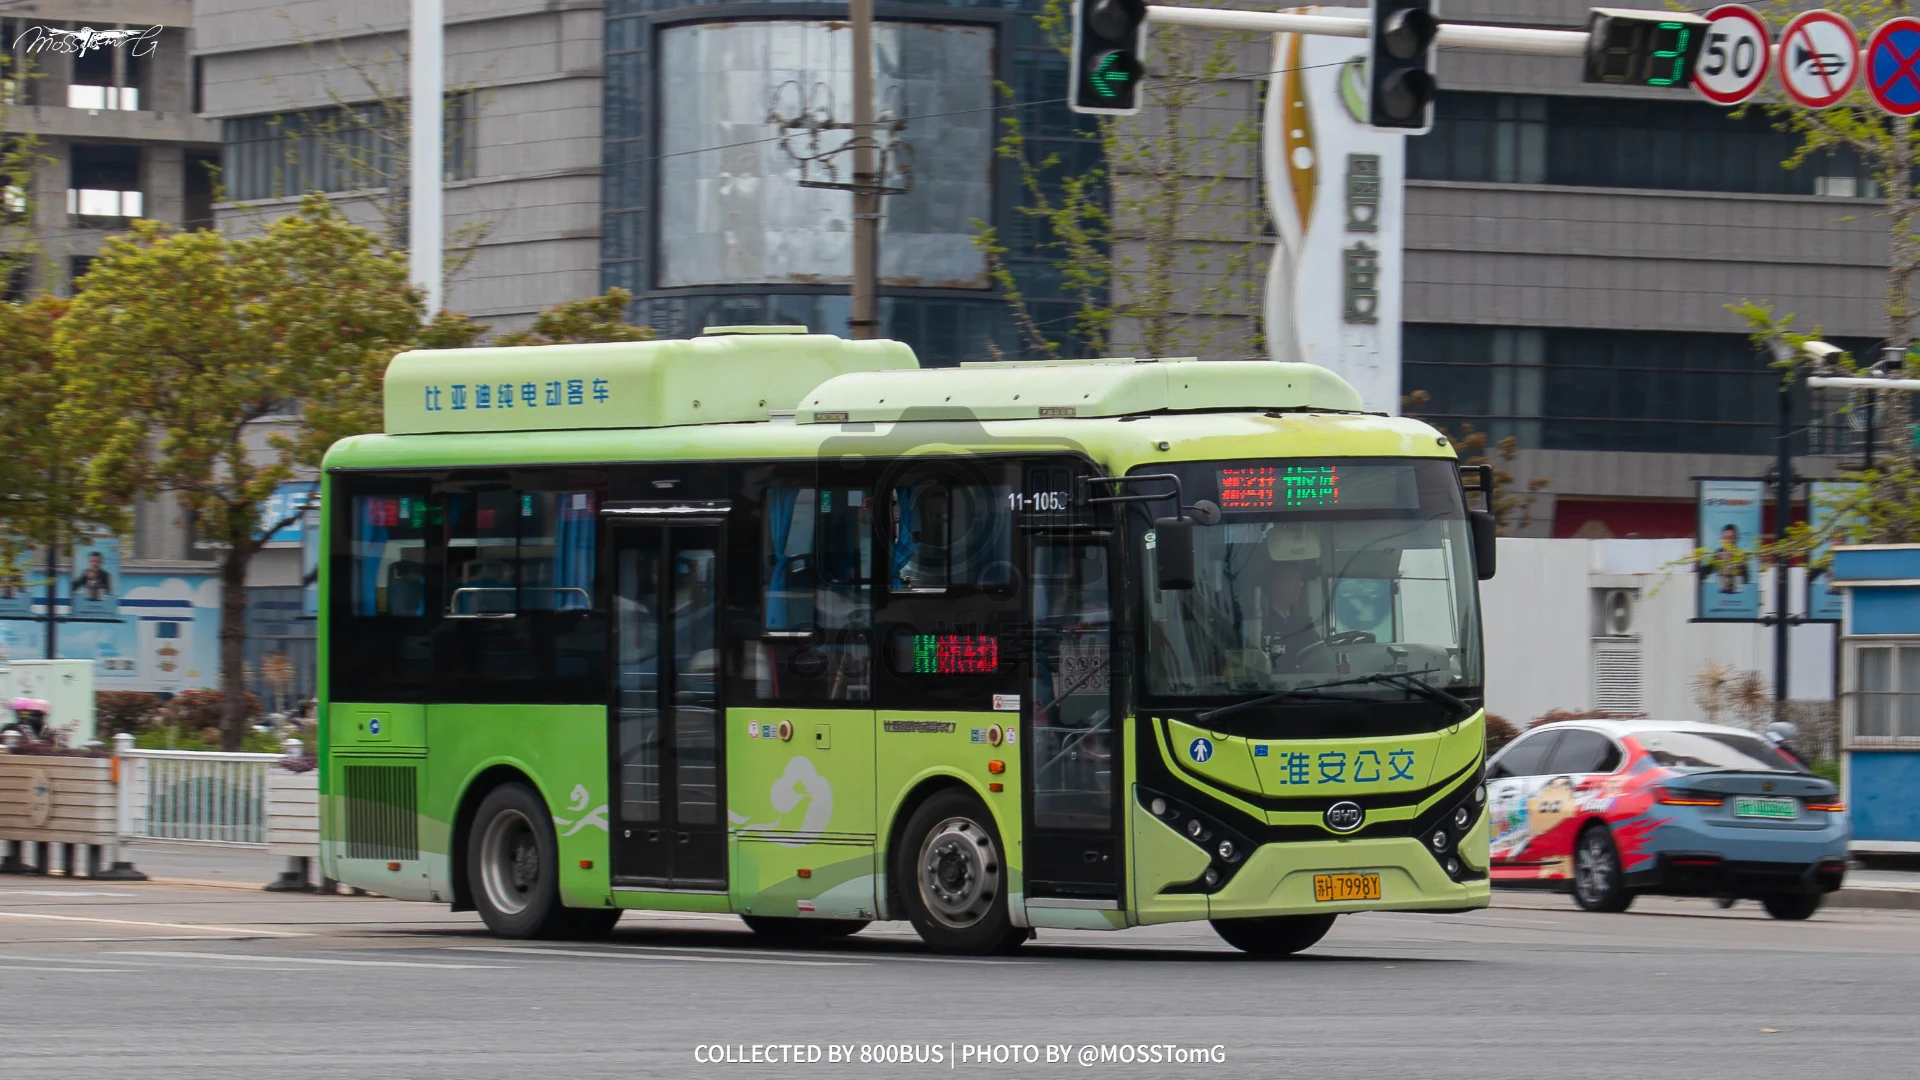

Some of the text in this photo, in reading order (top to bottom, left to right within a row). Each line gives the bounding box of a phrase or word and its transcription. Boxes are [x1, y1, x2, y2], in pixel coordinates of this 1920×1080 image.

[1645, 22, 1691, 85] 3
[1703, 33, 1755, 78] 50
[425, 378, 609, 411] 比亚迪纯电动客车
[1280, 748, 1415, 785] 淮安公交
[1332, 809, 1358, 821] BYD
